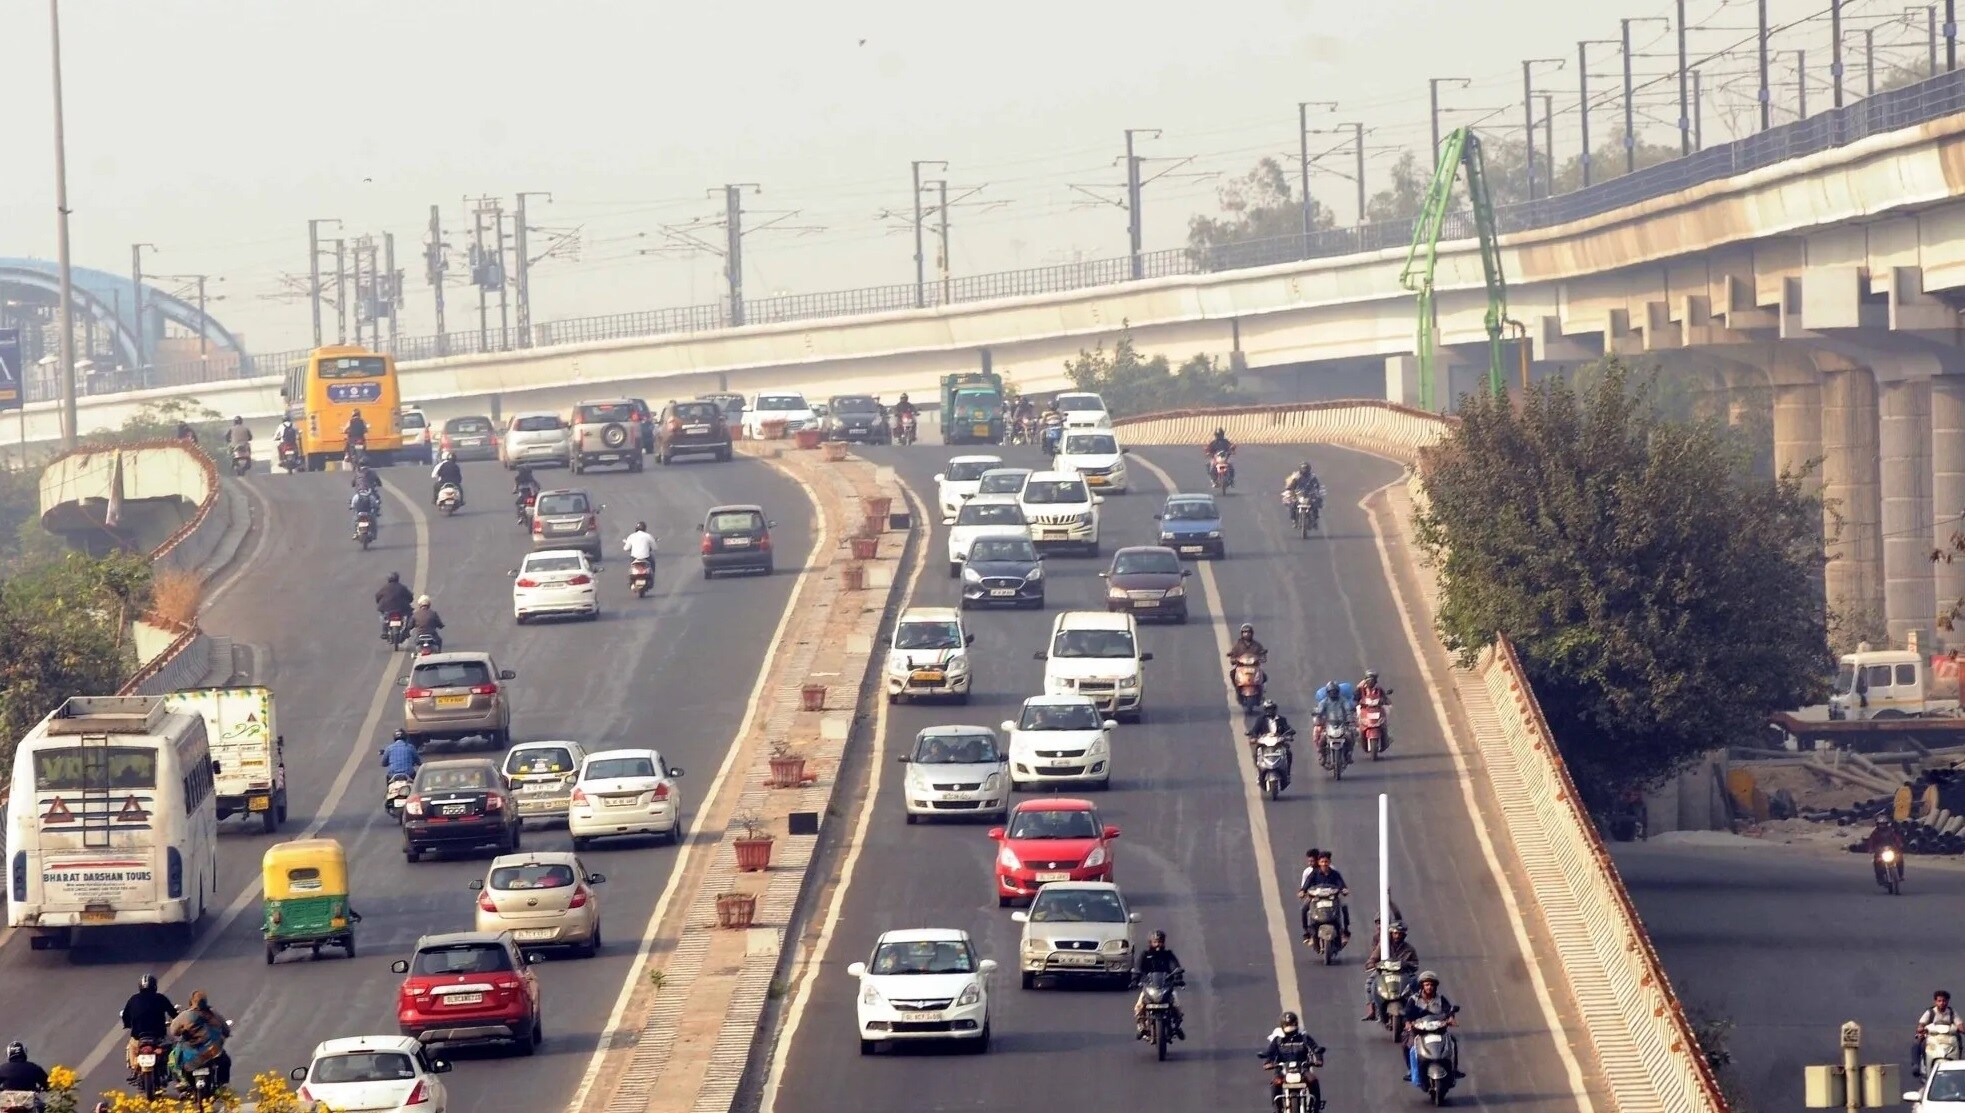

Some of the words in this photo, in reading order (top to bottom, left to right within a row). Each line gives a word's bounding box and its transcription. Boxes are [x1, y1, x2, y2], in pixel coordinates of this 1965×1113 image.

[43, 873, 80, 882] BHARAT
[83, 873, 123, 881] DARSHAN
[126, 872, 152, 881] TOURS
